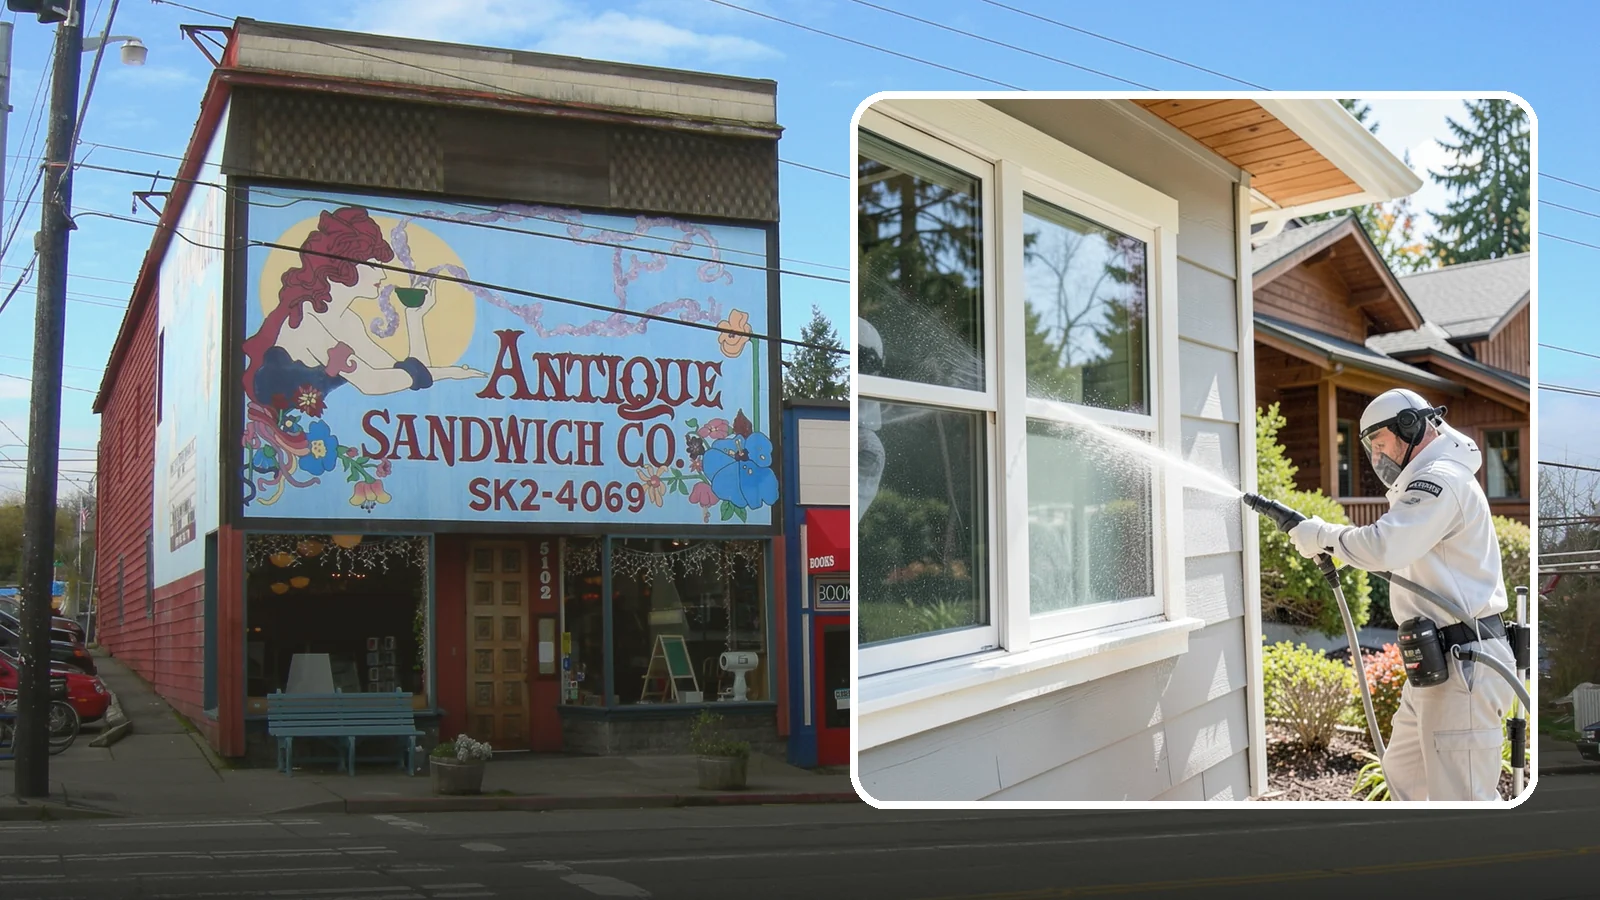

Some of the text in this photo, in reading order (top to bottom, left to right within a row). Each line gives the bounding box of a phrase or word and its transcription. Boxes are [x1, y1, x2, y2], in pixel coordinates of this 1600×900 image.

[475, 329, 724, 421] ANTIQUE
[361, 408, 685, 469] SANDWICH CO.
[468, 477, 646, 513] SK2-4069
[540, 542, 552, 599] 5102
[809, 555, 835, 569] BOOKS
